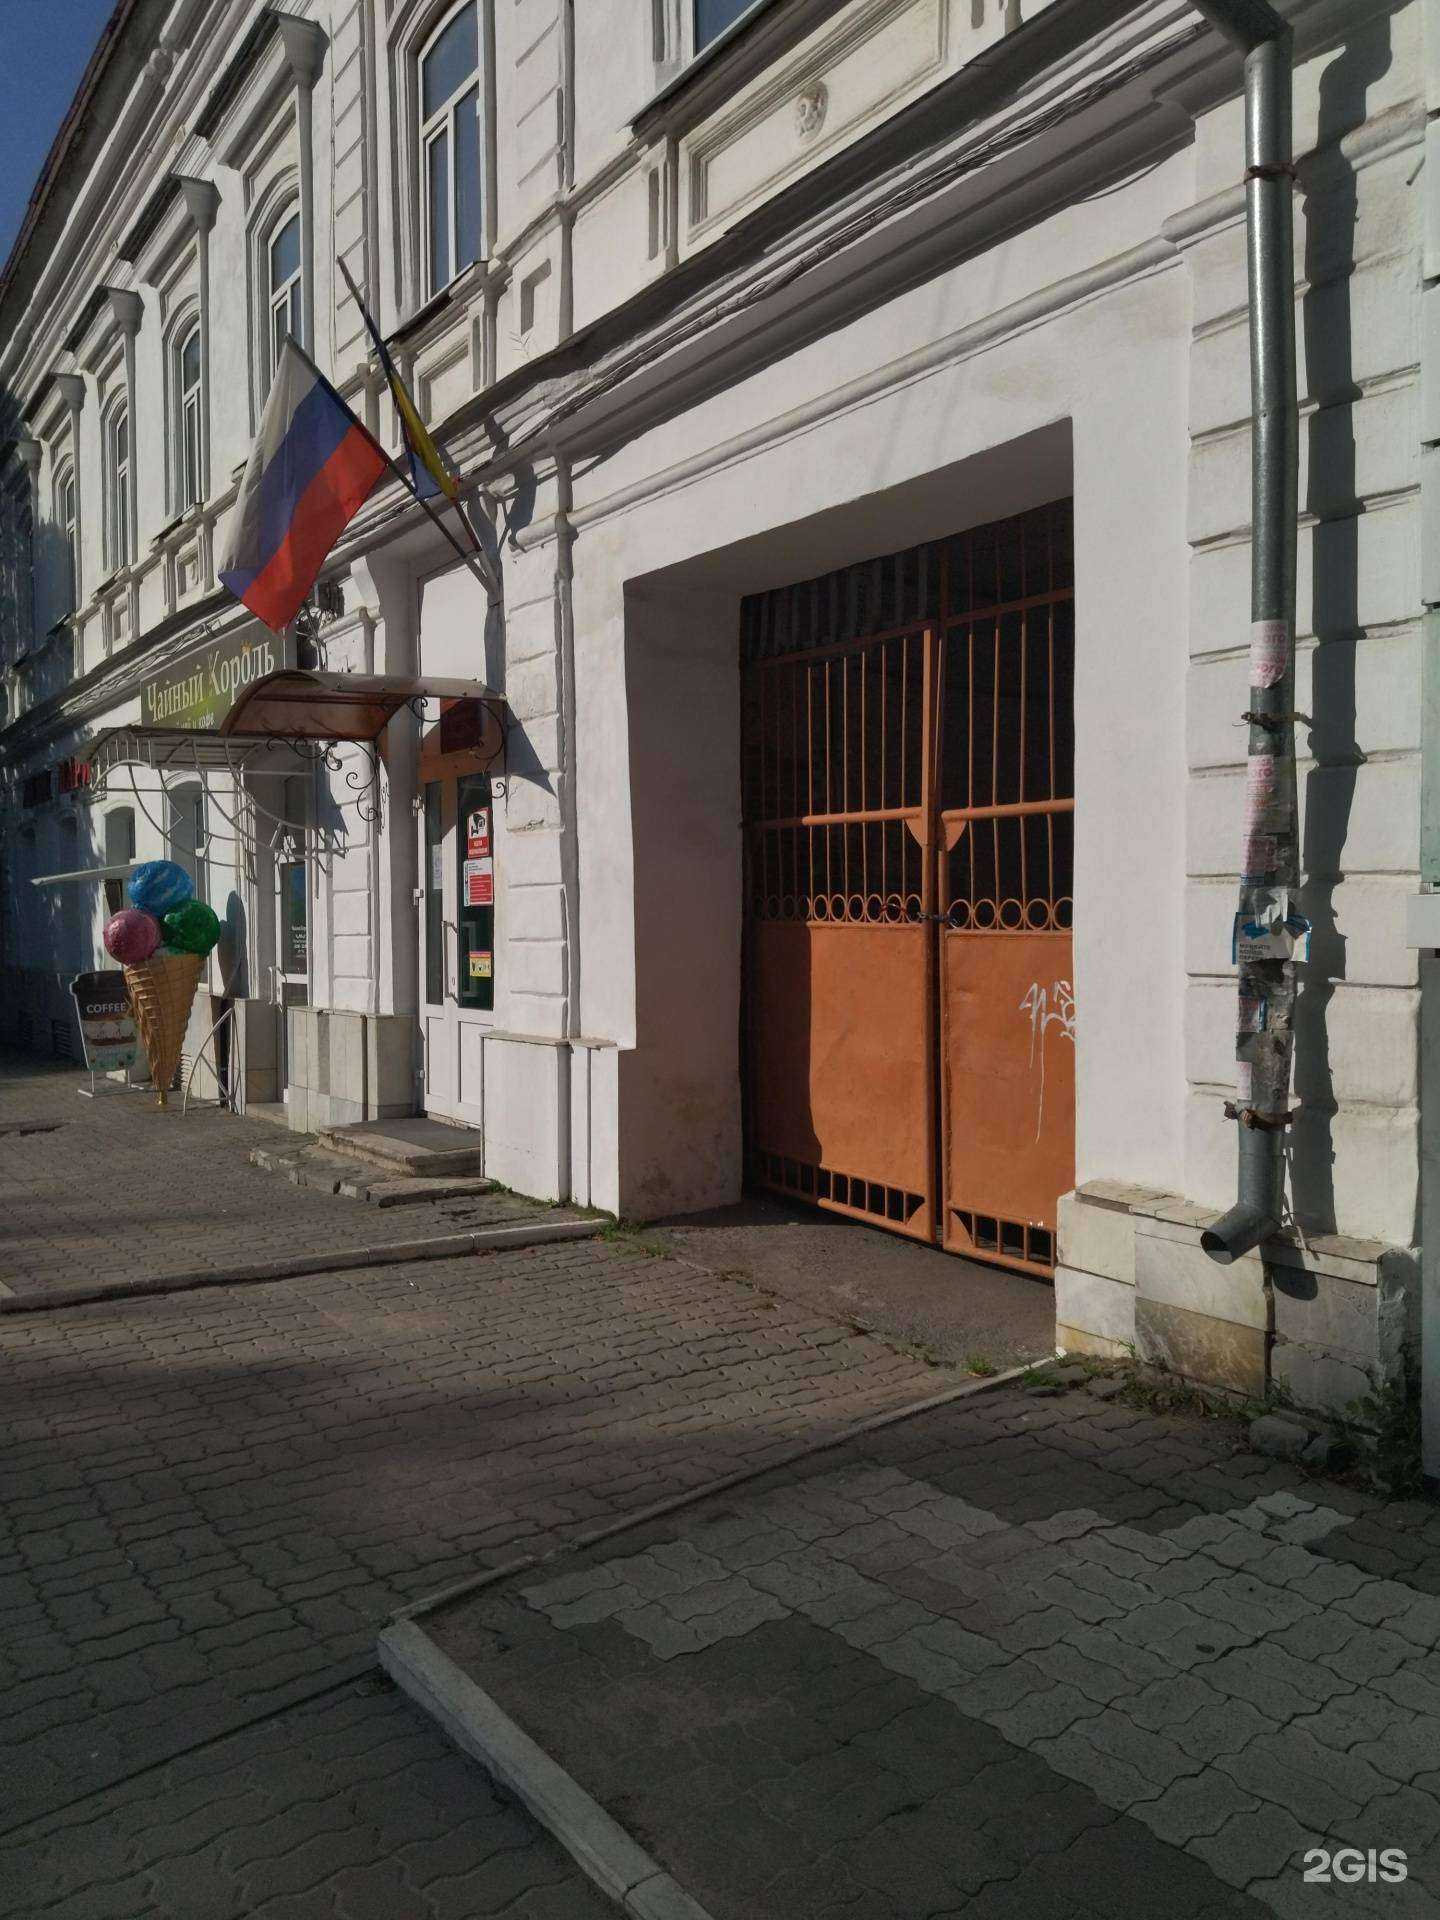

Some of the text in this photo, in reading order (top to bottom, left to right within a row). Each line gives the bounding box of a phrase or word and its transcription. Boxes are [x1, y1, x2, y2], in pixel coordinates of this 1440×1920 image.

[147, 641, 275, 722] Чайный Король
[86, 1002, 127, 1013] COFFEE
